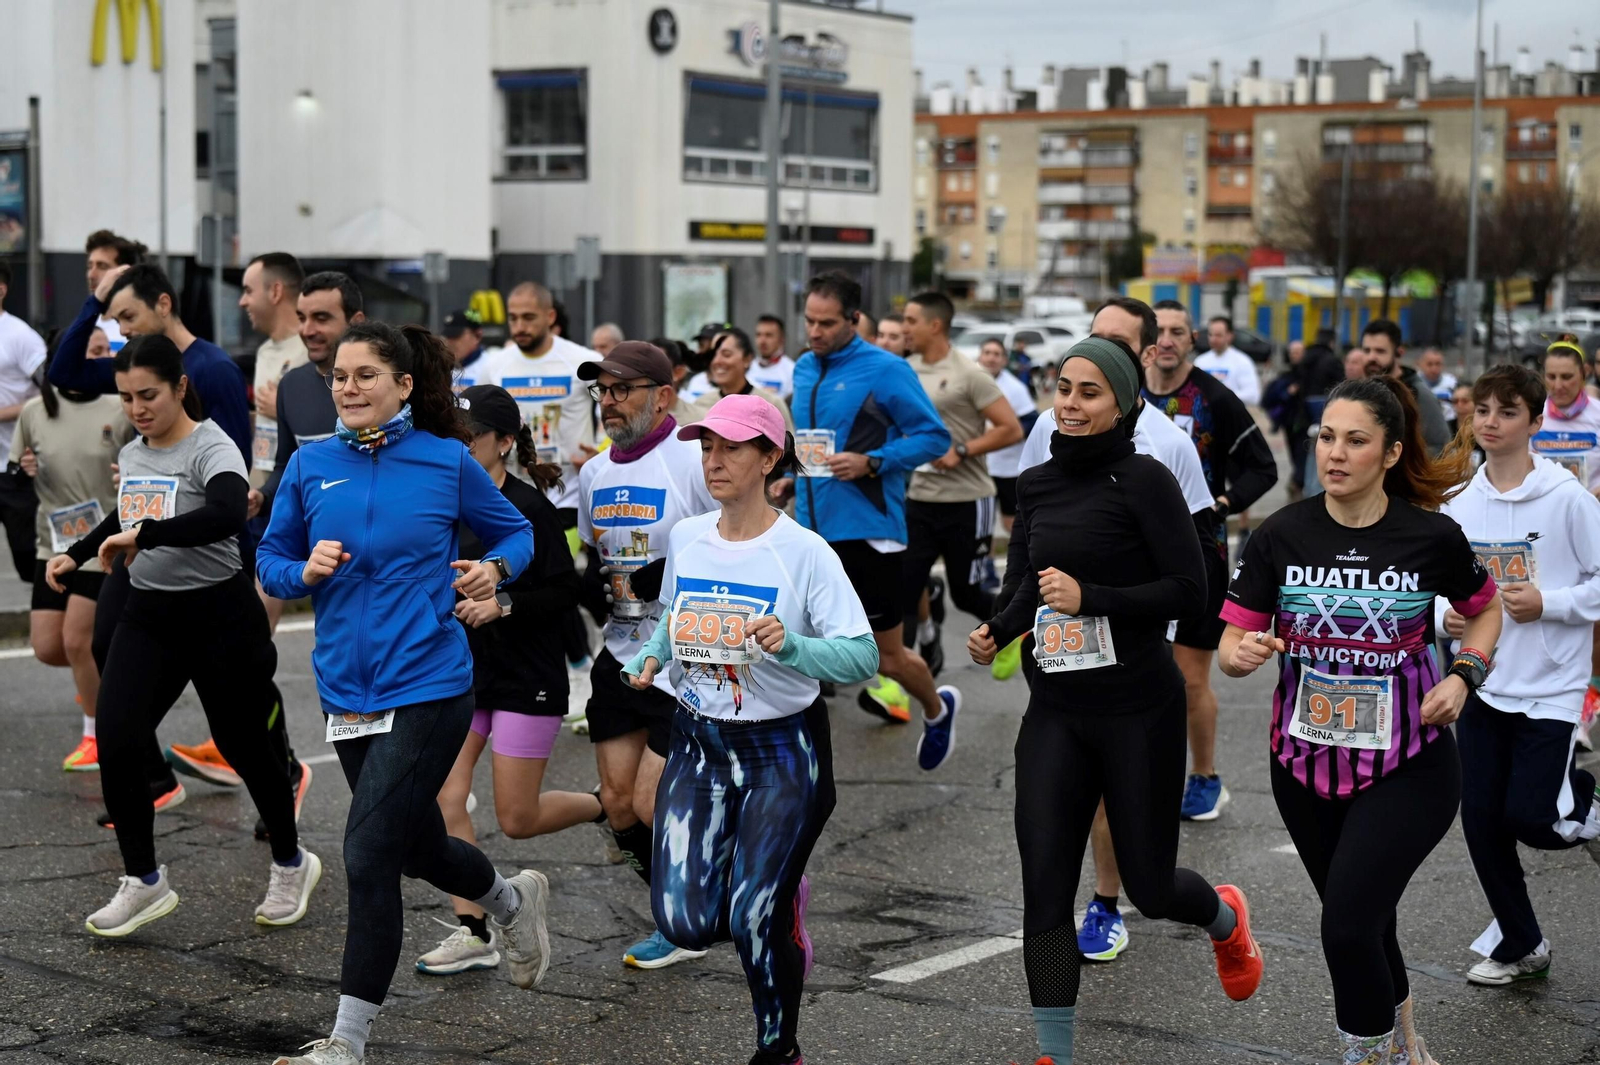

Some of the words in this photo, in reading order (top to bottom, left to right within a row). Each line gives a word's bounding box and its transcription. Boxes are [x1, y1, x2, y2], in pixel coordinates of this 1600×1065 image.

[120, 493, 164, 521] 234
[614, 489, 630, 502] 12
[1285, 565, 1419, 592] DUATLÓN
[675, 611, 745, 648] 293
[1306, 593, 1397, 644] XX
[1043, 621, 1085, 655] 95
[1289, 641, 1312, 660] LA
[1313, 645, 1408, 670] VICTORIA
[1308, 693, 1357, 729] 91
